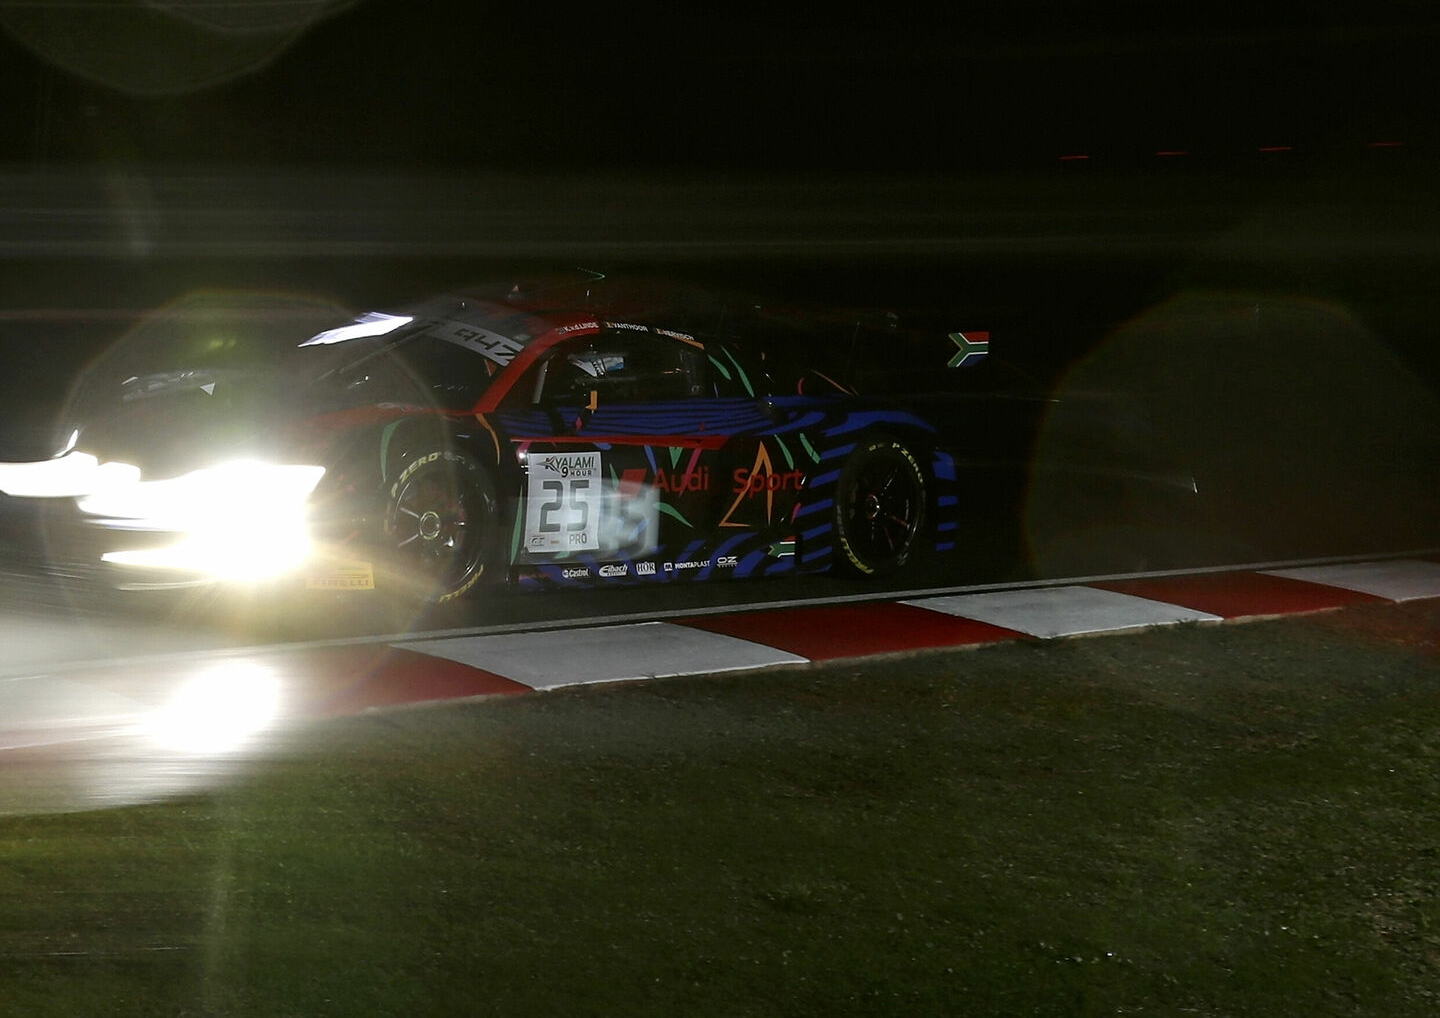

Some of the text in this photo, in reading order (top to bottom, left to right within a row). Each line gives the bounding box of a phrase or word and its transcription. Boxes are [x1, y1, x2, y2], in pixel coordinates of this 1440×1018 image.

[399, 452, 442, 484] ZERO
[536, 456, 594, 474] KYALAMI
[561, 466, 592, 478] 9 HOUR
[653, 466, 804, 499] Audi Sport
[539, 479, 590, 533] 25
[569, 533, 588, 545] PRO
[569, 568, 589, 578] Castrol
